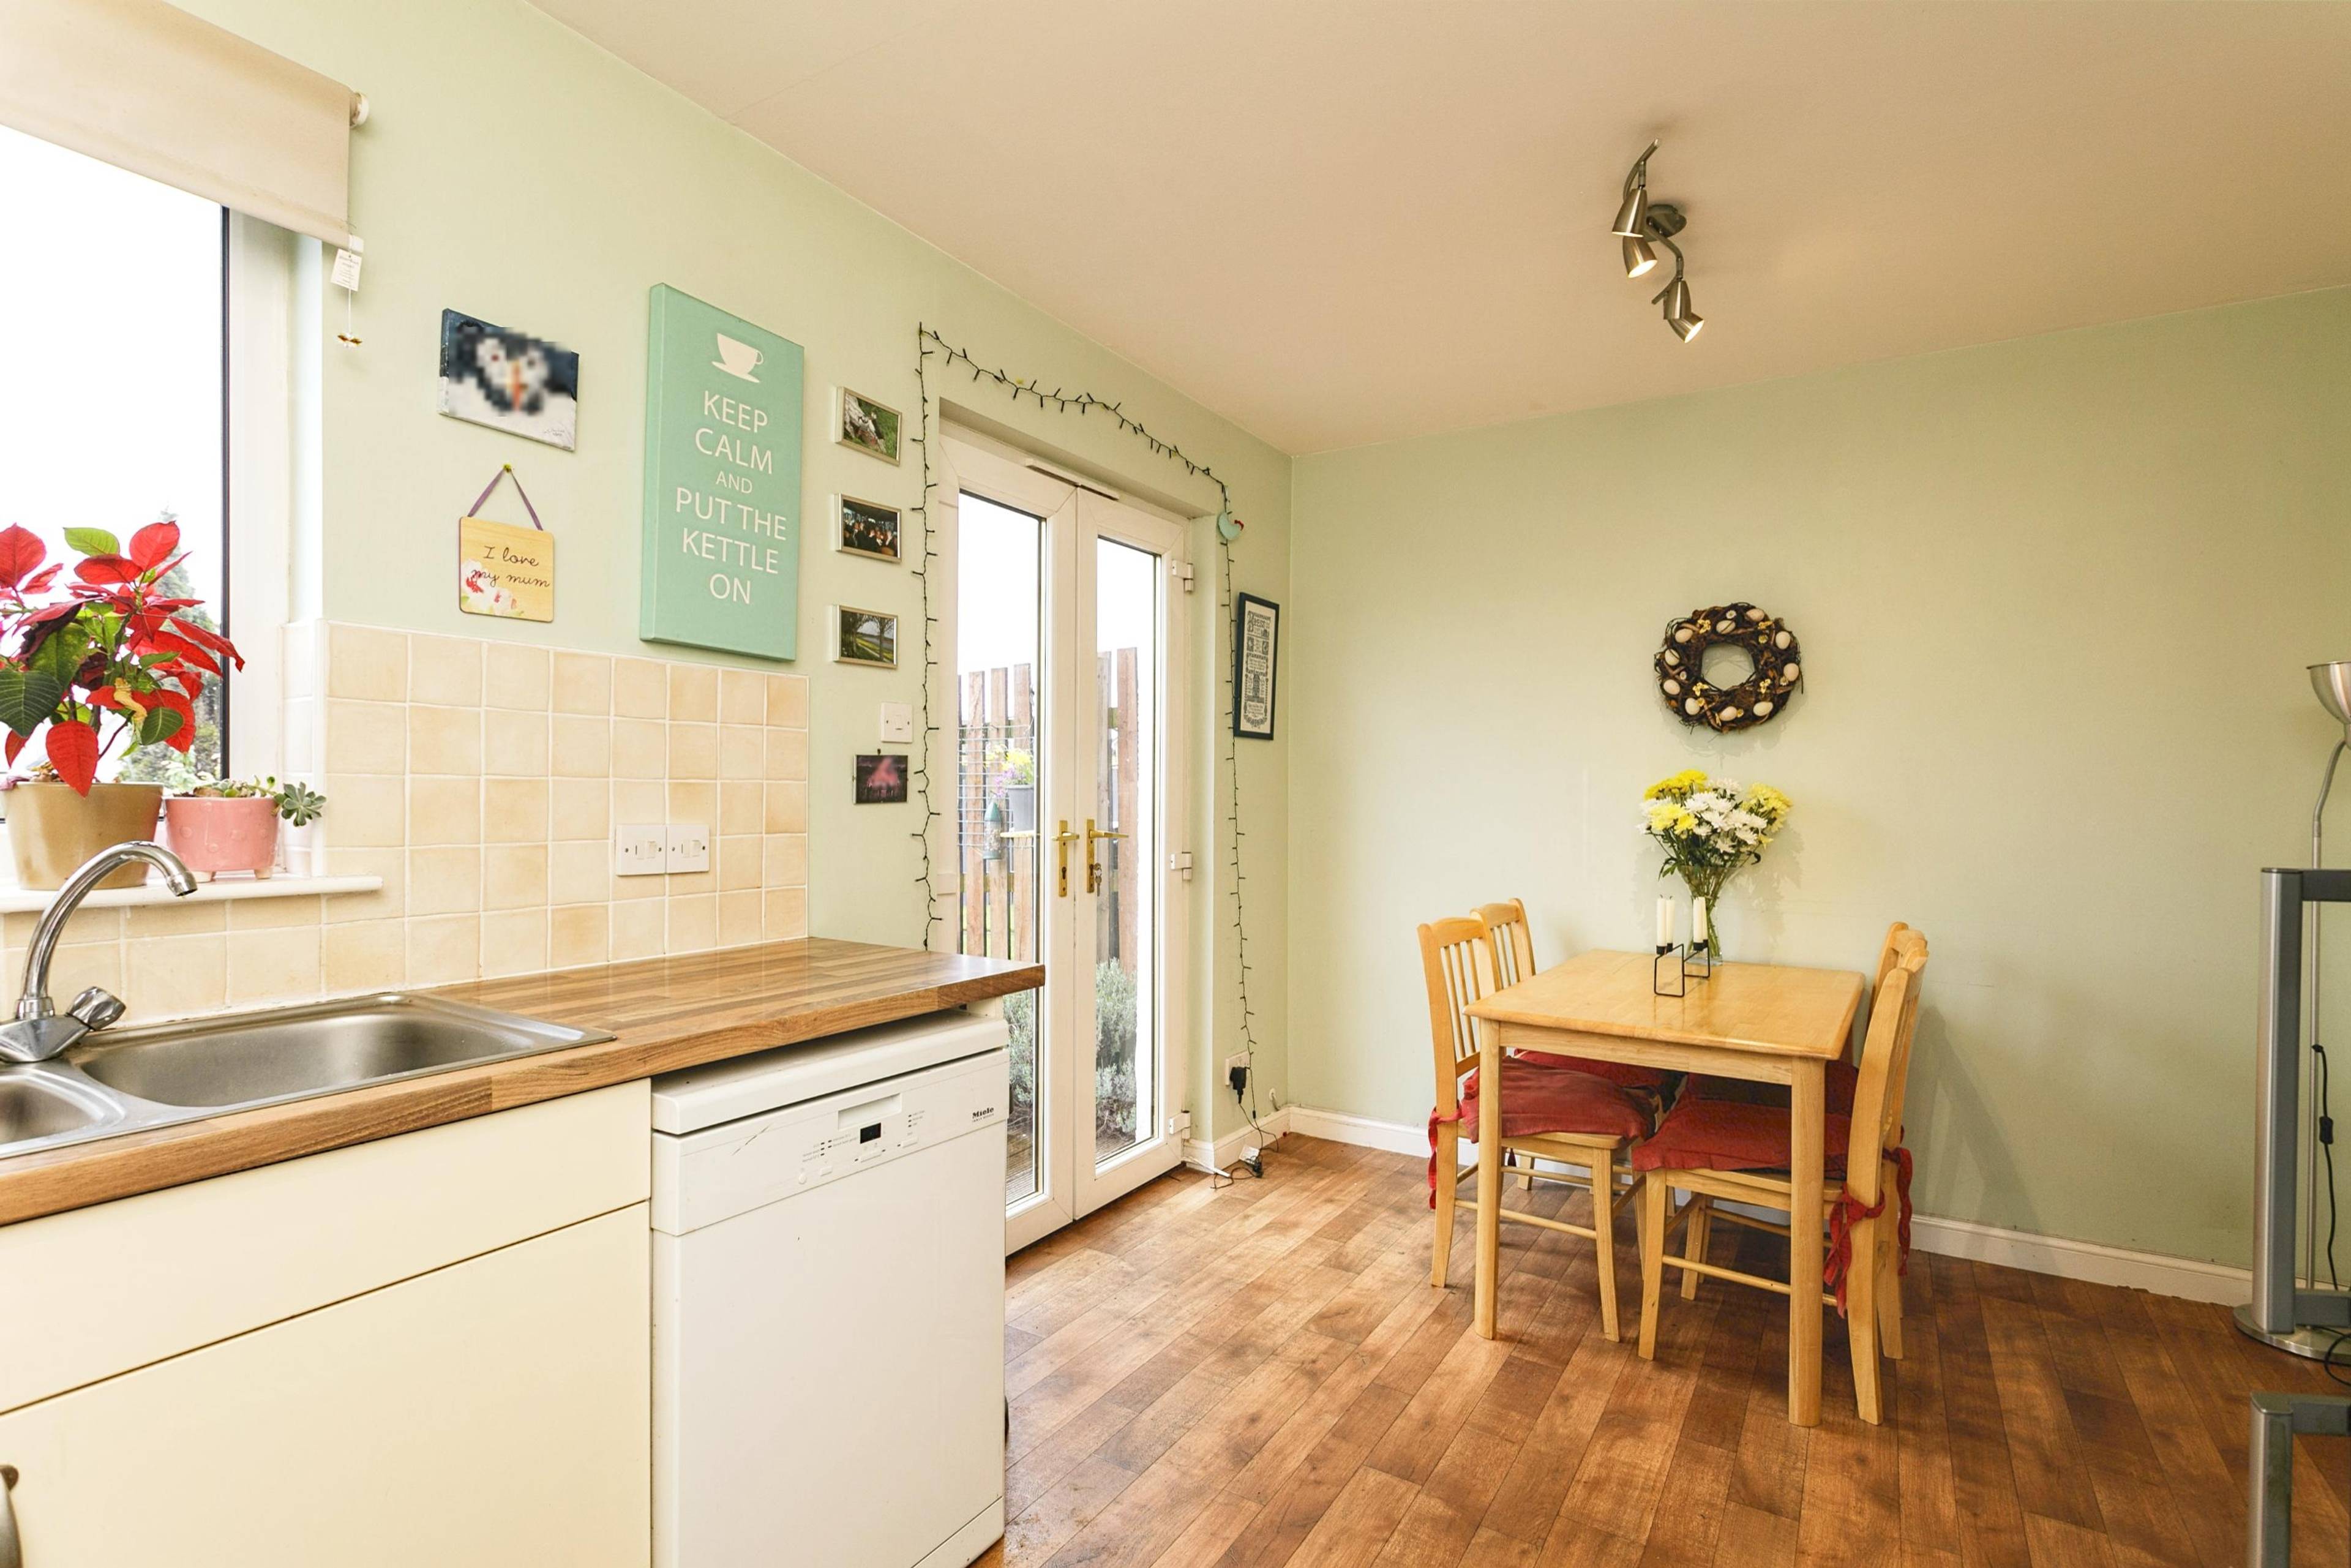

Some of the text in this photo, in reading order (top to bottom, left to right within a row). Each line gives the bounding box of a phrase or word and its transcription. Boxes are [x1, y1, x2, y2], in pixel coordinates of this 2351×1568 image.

[705, 391, 768, 433] KEEP
[695, 428, 772, 475] CALM
[716, 470, 752, 493] AND
[676, 487, 787, 541] PUT THE
[483, 546, 539, 566] I love
[683, 528, 778, 574] KETTLE
[471, 569, 550, 587] my mum
[710, 573, 751, 604] ON
[972, 1107, 994, 1119] Miele
